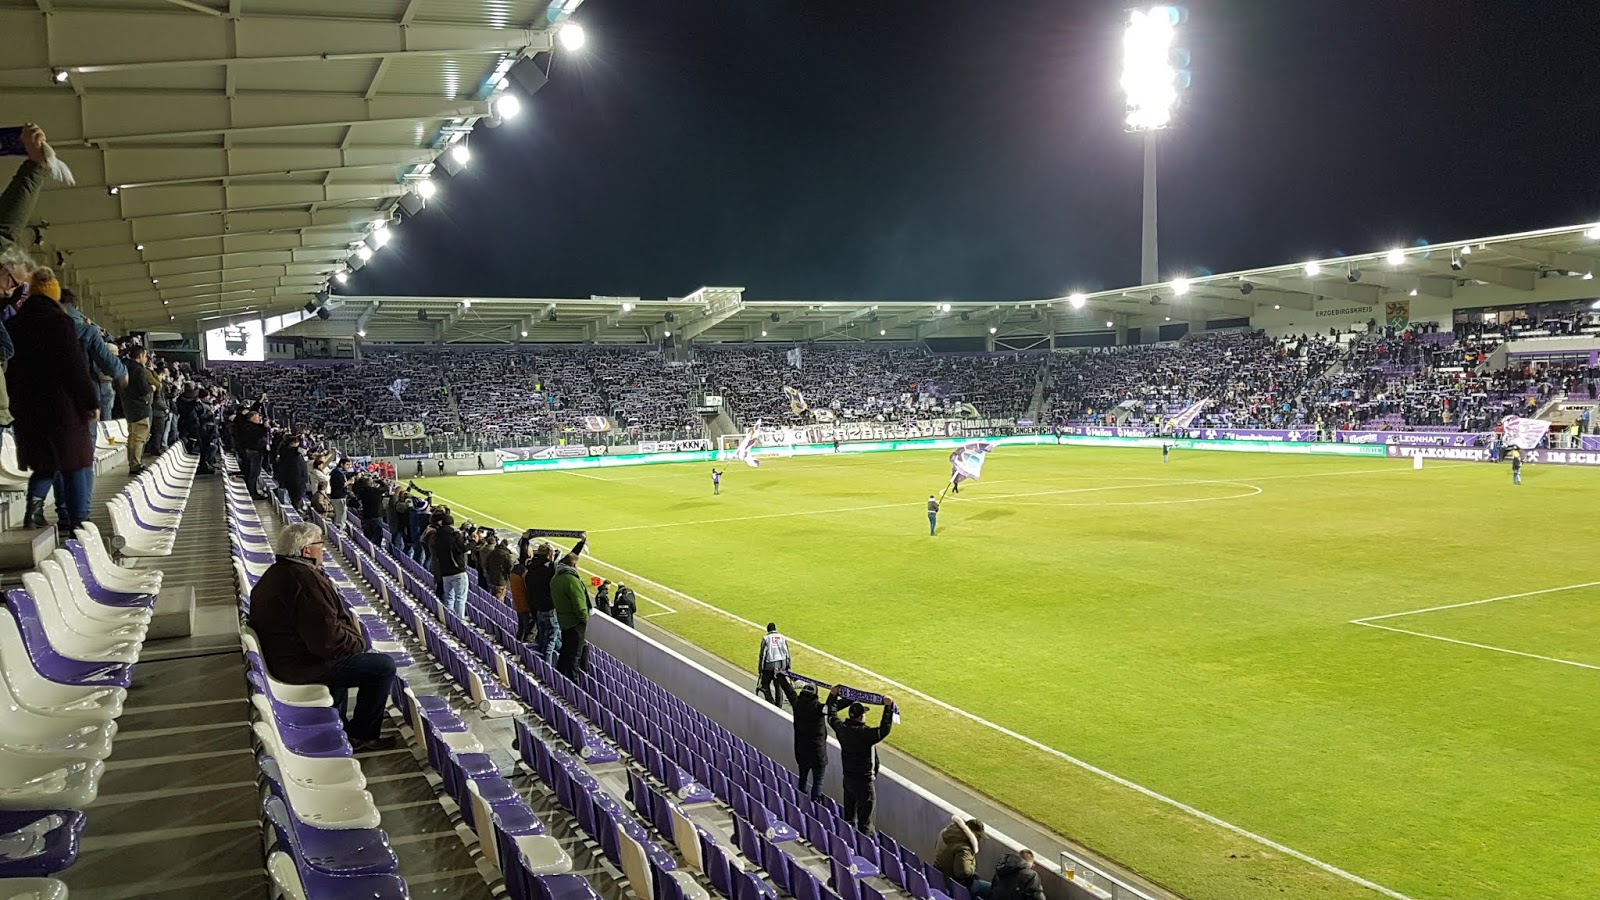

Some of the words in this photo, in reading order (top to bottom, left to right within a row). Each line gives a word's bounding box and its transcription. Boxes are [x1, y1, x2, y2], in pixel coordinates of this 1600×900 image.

[1315, 306, 1373, 317] ERZGEBIRGSKREIS
[1123, 430, 1146, 438] Helios
[1400, 447, 1483, 459] WILLKOMMEN
[1547, 452, 1567, 463] IM
